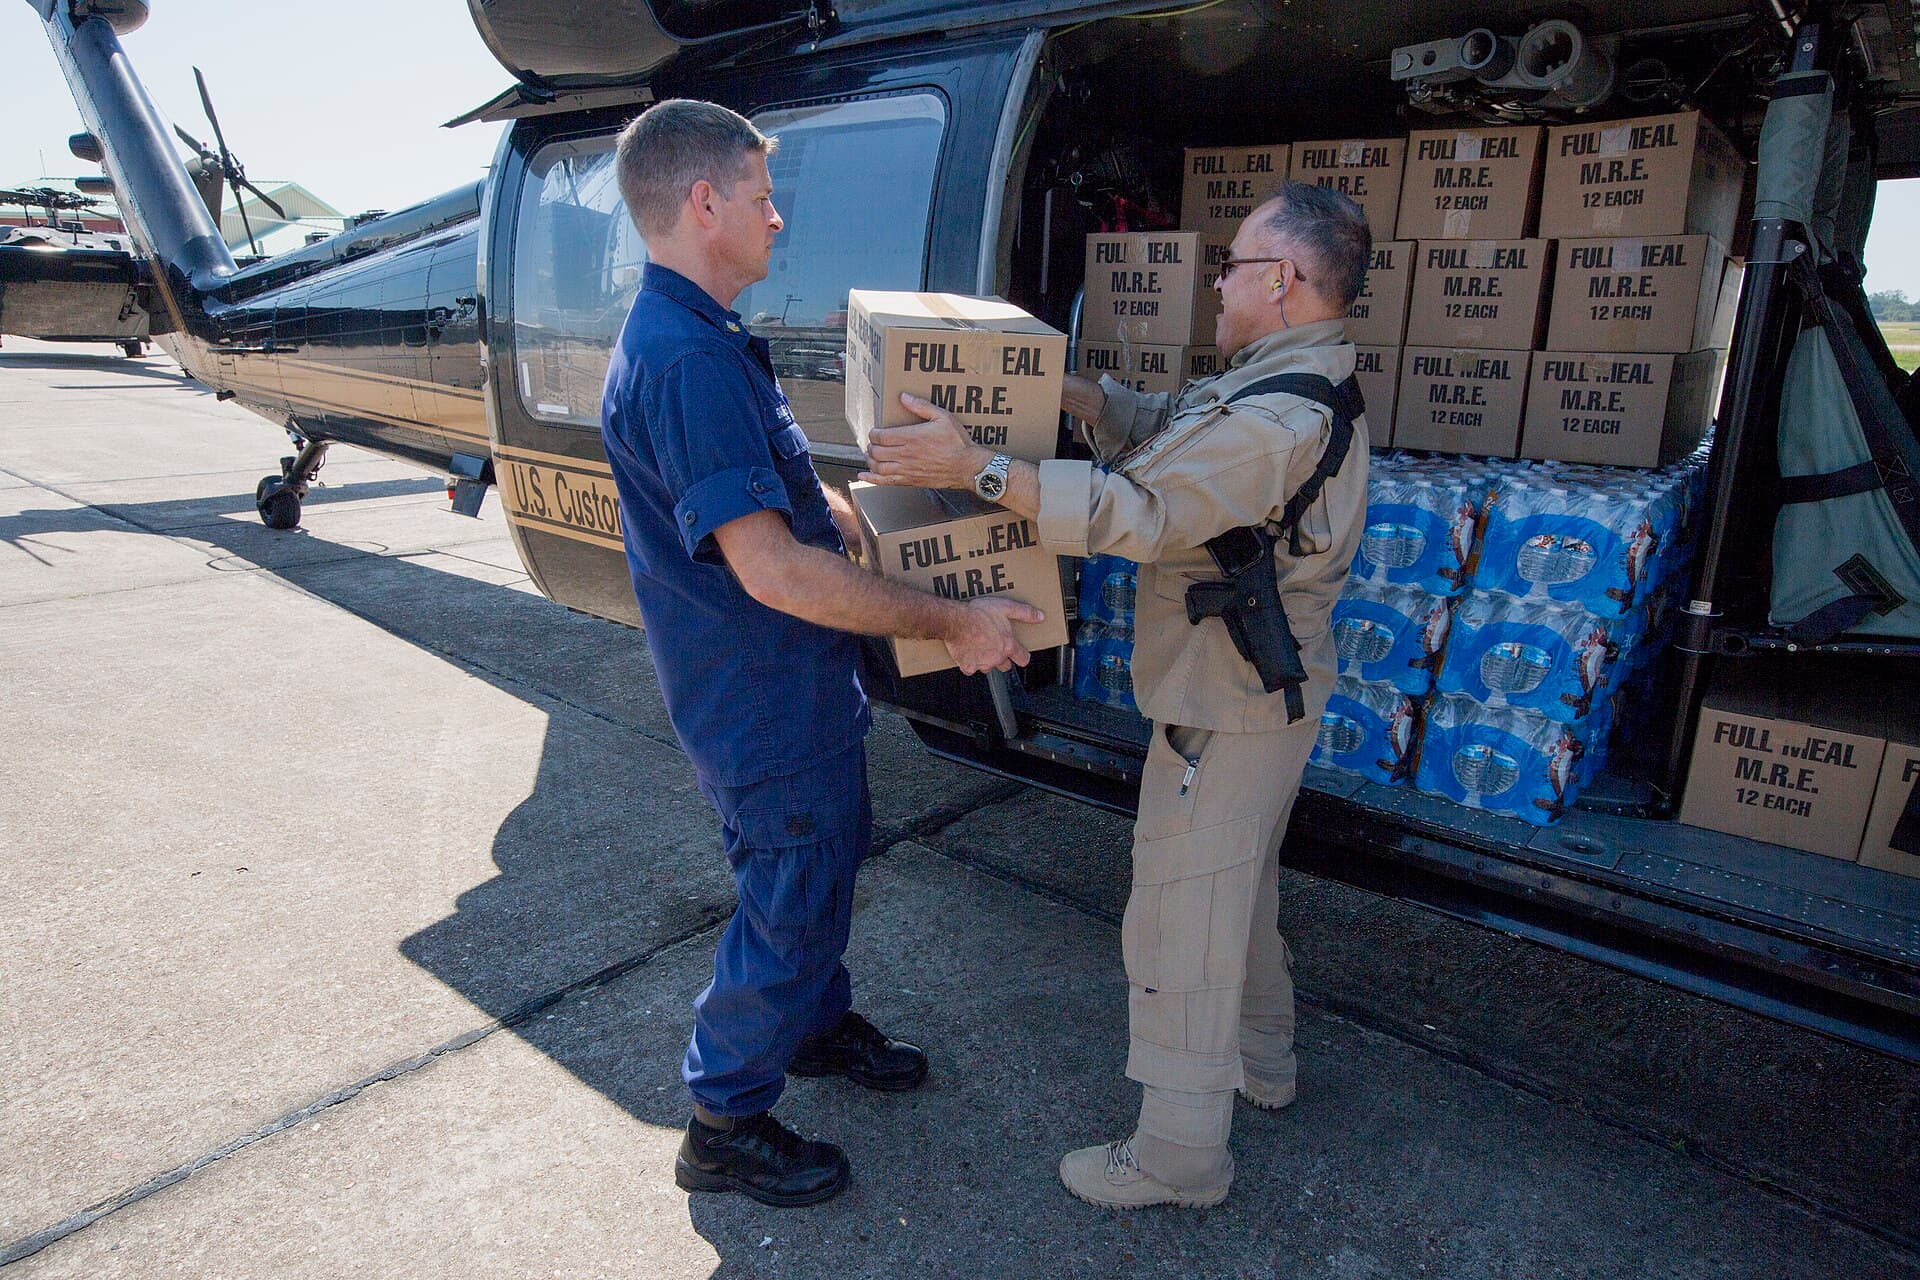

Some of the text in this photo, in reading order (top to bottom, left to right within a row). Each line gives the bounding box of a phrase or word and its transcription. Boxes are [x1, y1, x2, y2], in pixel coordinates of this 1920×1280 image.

[1193, 153, 1274, 175] FULL EAL
[1302, 147, 1390, 169] FULL EAL
[1433, 166, 1493, 188] M.R.E.
[1580, 158, 1648, 185] M.R.E.
[1207, 180, 1254, 199] M.R.E.
[1317, 175, 1368, 196] MR.E.
[1435, 195, 1488, 210] 12 EACH
[1583, 189, 1644, 208] 12 EACH
[1209, 205, 1222, 218] 12
[1427, 248, 1528, 270] FULL EAL
[1111, 271, 1162, 293] M.R.E.
[1443, 276, 1503, 297] M.R.E.
[1588, 275, 1657, 298] M.R.E.
[1113, 299, 1160, 316] 12 EACH
[1345, 303, 1370, 319] ACH
[1445, 303, 1499, 319] 12 EACH
[1590, 305, 1610, 320] 12
[903, 342, 966, 374] FULL
[1001, 346, 1046, 377] EAL
[1086, 348, 1169, 374] FULL EAL
[1354, 351, 1384, 373] EAL
[1413, 356, 1454, 377] FULL
[1543, 360, 1590, 382] FULL
[930, 384, 1013, 415] M.R.E.
[1429, 383, 1487, 406] M.R.E.
[1560, 389, 1625, 413] M.R.E.
[1431, 410, 1483, 427] 12 EACH
[1562, 417, 1622, 435] 12 EACH
[511, 463, 552, 518] U.S.
[899, 534, 961, 571] FULL
[932, 563, 1015, 600] M.R.E.
[1713, 721, 1773, 753] FULL
[1734, 756, 1819, 794] M.R.E.
[1736, 788, 1812, 818] 12 EACH
